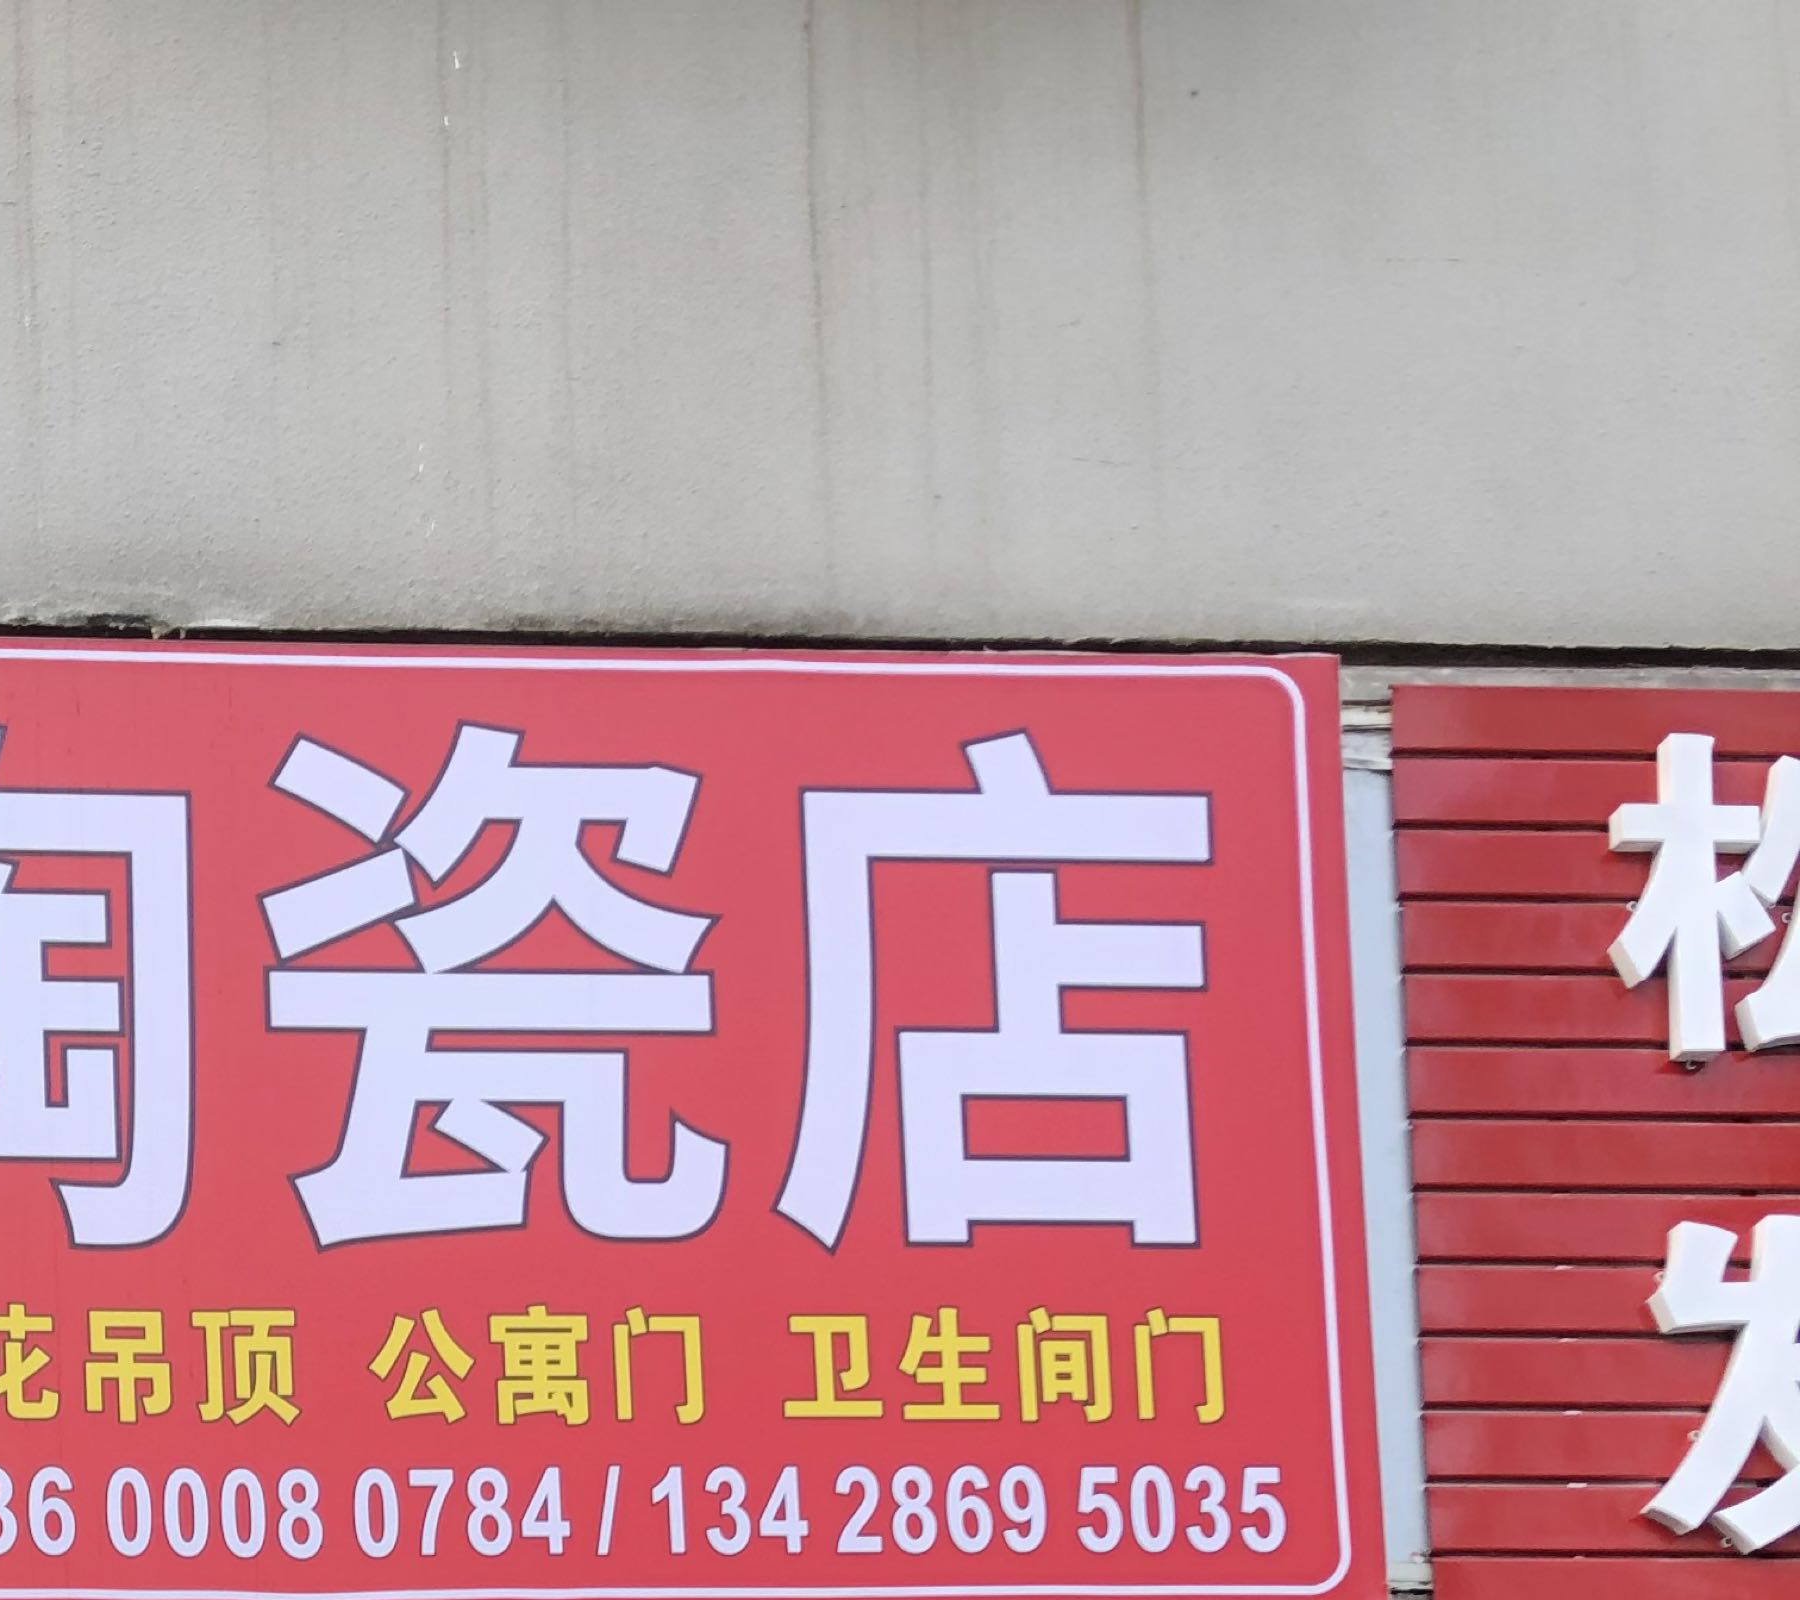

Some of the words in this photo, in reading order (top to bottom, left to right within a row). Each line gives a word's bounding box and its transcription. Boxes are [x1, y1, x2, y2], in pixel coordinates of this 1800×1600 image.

[369, 1303, 708, 1427] 公寓门
[784, 1307, 1226, 1427] 卫生间门
[104, 1465, 325, 1560] 0008
[353, 1464, 571, 1560] 0784
[652, 1463, 811, 1557] 134
[836, 1463, 1042, 1557] 2869
[1076, 1464, 1289, 1557] 5035
